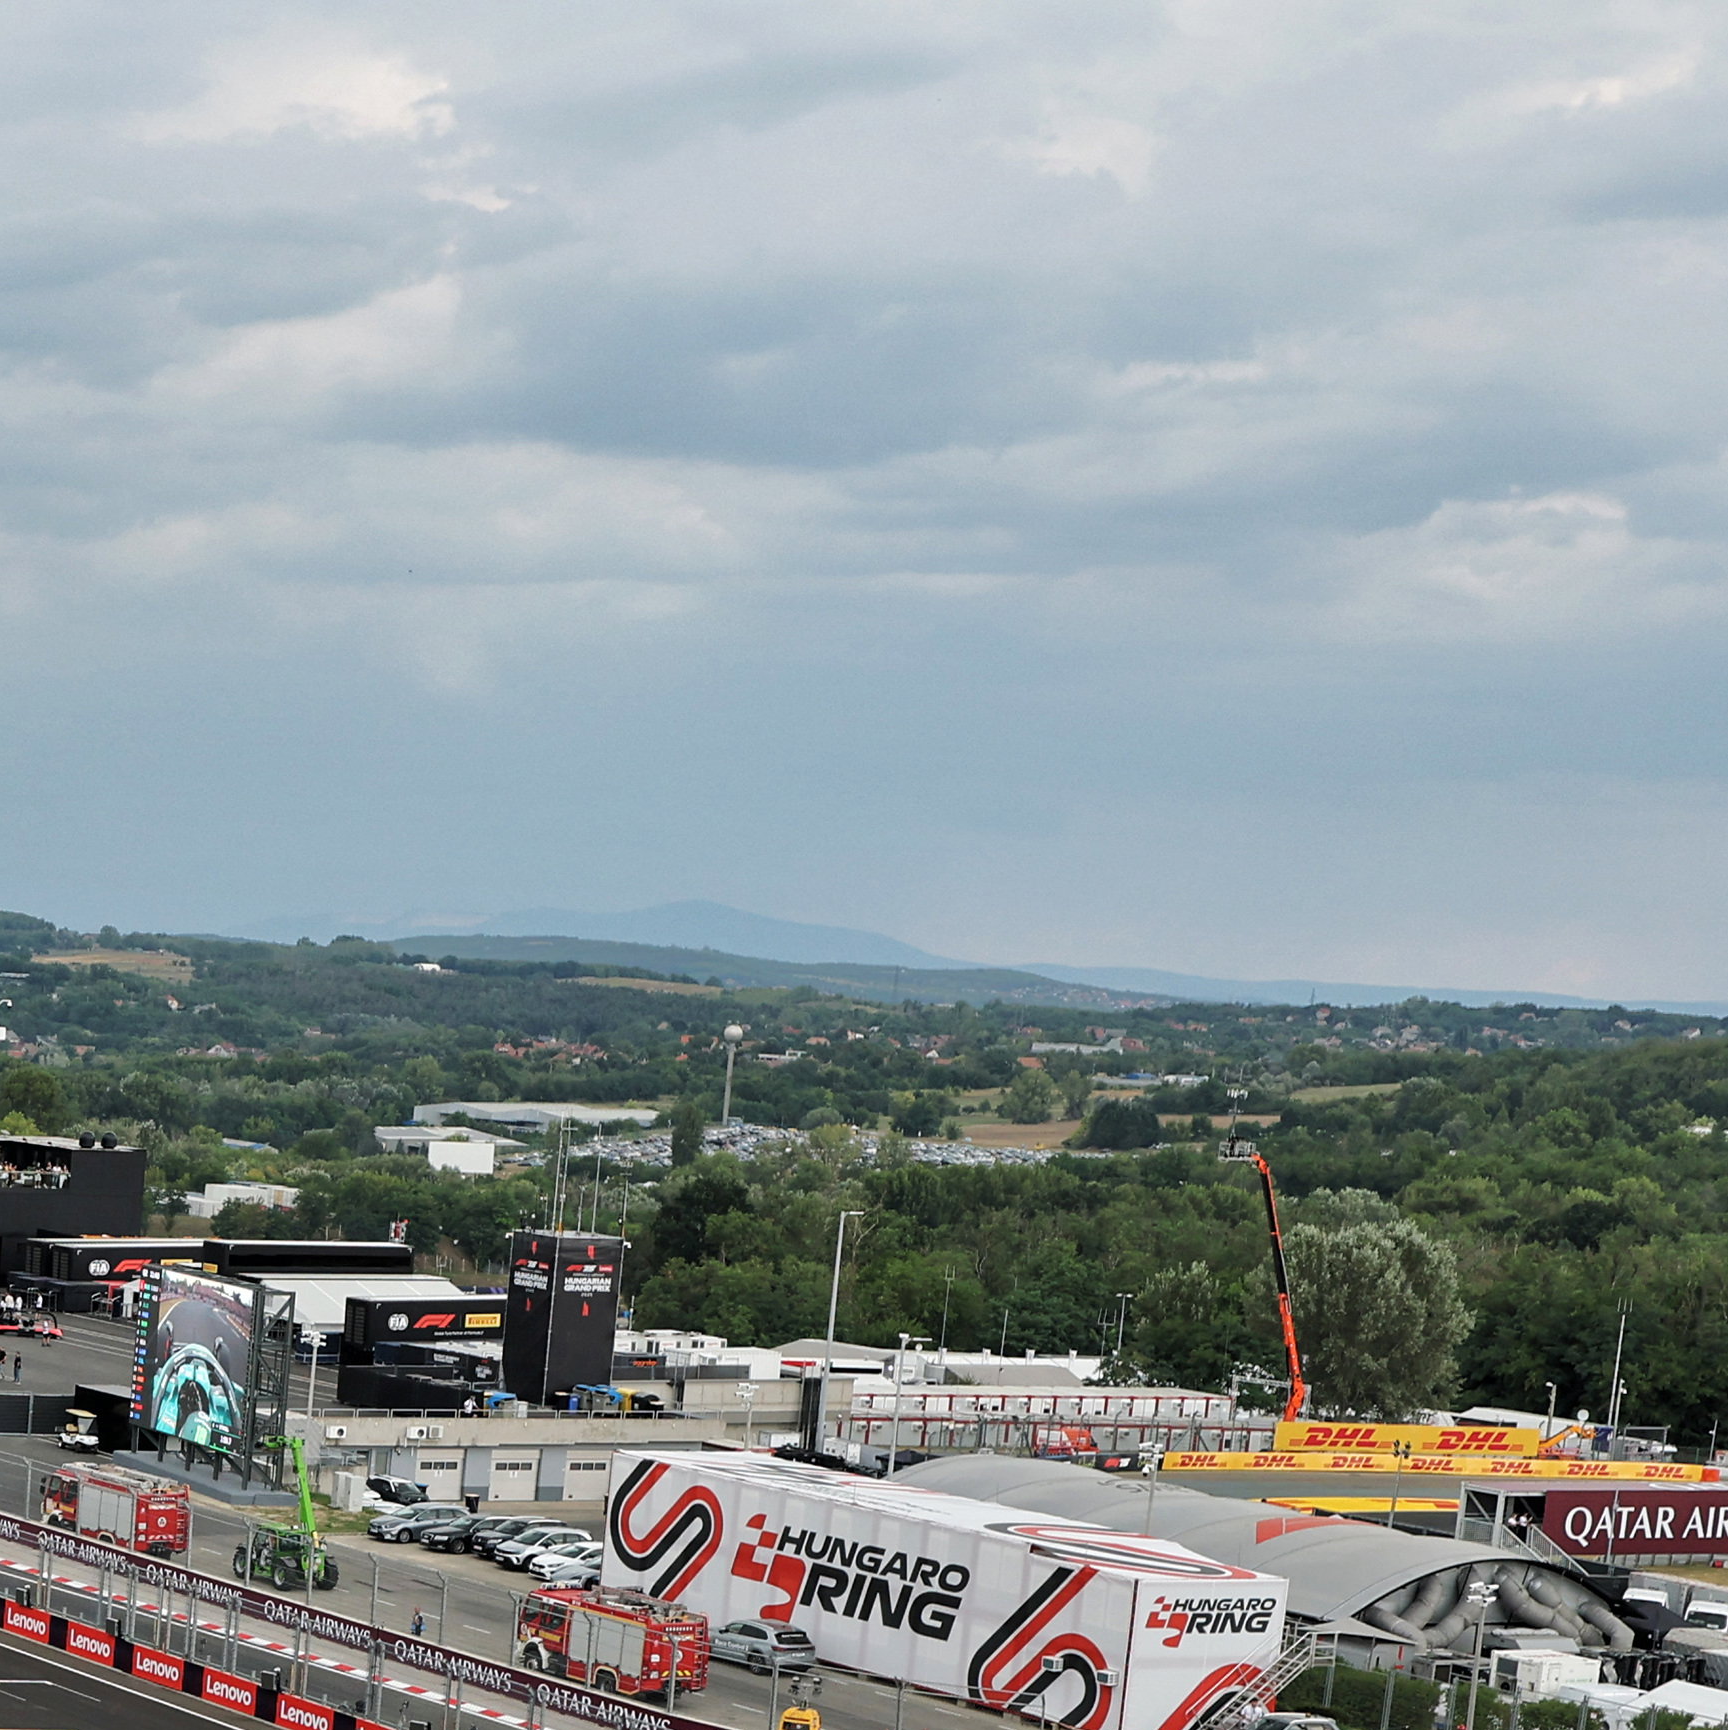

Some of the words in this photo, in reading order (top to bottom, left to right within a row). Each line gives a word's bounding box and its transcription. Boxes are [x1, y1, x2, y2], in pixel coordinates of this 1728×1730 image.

[89, 1260, 109, 1276] FIA
[514, 1271, 548, 1283] HUNGARIAN
[564, 1277, 612, 1286] HUNGARIAN
[564, 1284, 591, 1293] GRAND
[592, 1285, 611, 1293] PRIX
[388, 1314, 408, 1331] FIA
[467, 1315, 500, 1327] PIRELLI
[1303, 1427, 1380, 1448] DHL
[1438, 1429, 1511, 1451] DHL
[1179, 1455, 1219, 1468] DHL
[1251, 1455, 1296, 1468] DHL
[1331, 1456, 1375, 1469] DHL
[1410, 1458, 1455, 1471] DHL
[1490, 1461, 1534, 1474] DHL
[1567, 1464, 1610, 1476] DHL
[1644, 1465, 1687, 1479] DHL
[1564, 1506, 1675, 1546] QATAR
[38, 1531, 76, 1559] QATAR
[77, 1544, 127, 1573] AIRWAYS
[777, 1524, 971, 1593] HUNGARO
[145, 1564, 188, 1594] QATAR
[191, 1578, 243, 1606] AIRWAYS
[798, 1564, 962, 1642] RING
[1170, 1598, 1277, 1614] HUNGARO
[7, 1606, 46, 1635] Lenovo
[263, 1600, 310, 1632] QATAR
[312, 1613, 371, 1650] AIRWAYS
[1187, 1611, 1272, 1635] RING
[70, 1629, 111, 1658] Lenovo
[136, 1655, 180, 1682] Lenovo
[393, 1639, 443, 1670] QATAR
[447, 1656, 512, 1693] AIRWAYS
[206, 1678, 252, 1706] Lenovo
[536, 1684, 592, 1717] QATAR
